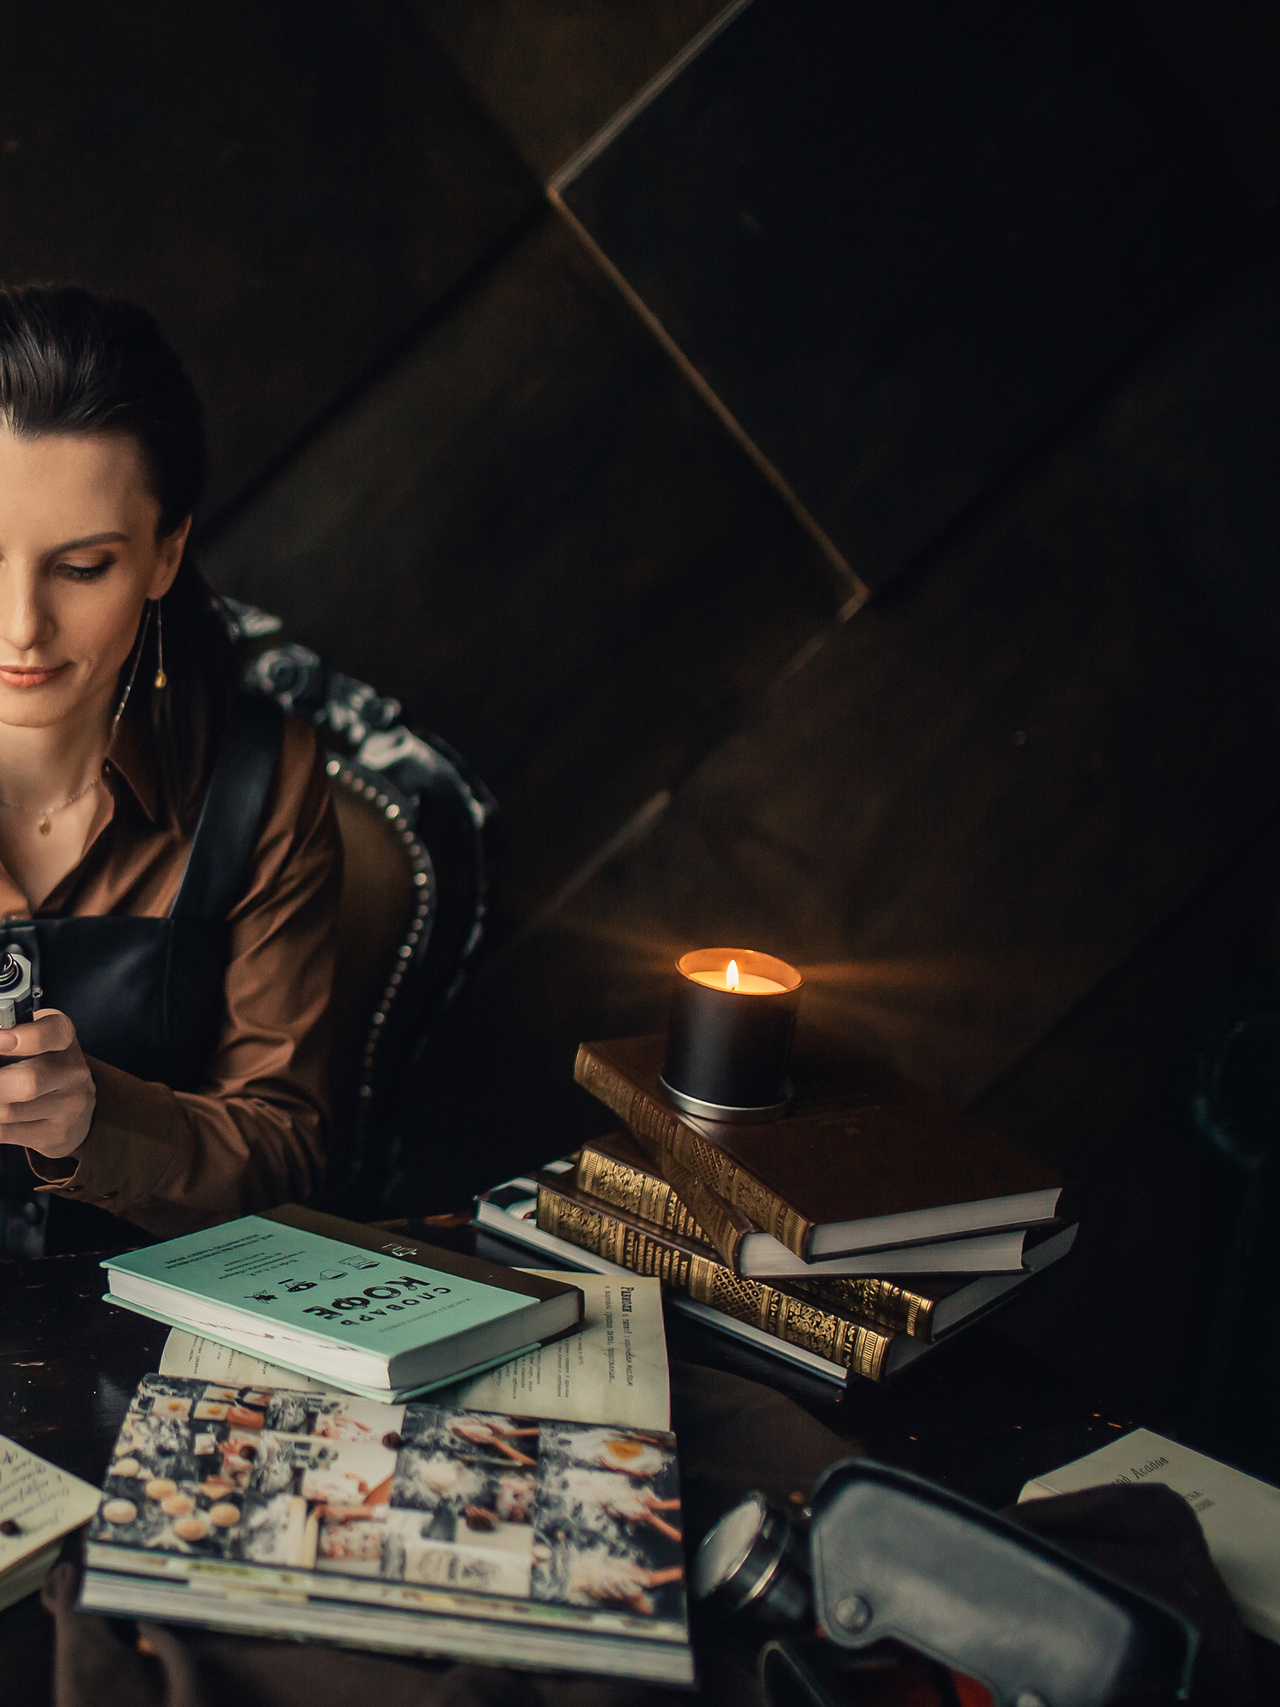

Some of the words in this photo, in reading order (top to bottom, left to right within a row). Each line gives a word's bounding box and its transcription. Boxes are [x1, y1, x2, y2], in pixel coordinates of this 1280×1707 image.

[302, 1275, 431, 1320] КОФЕ
[340, 1286, 452, 1326] СЛОВАРЬ
[1130, 1456, 1169, 1480] Асадов
